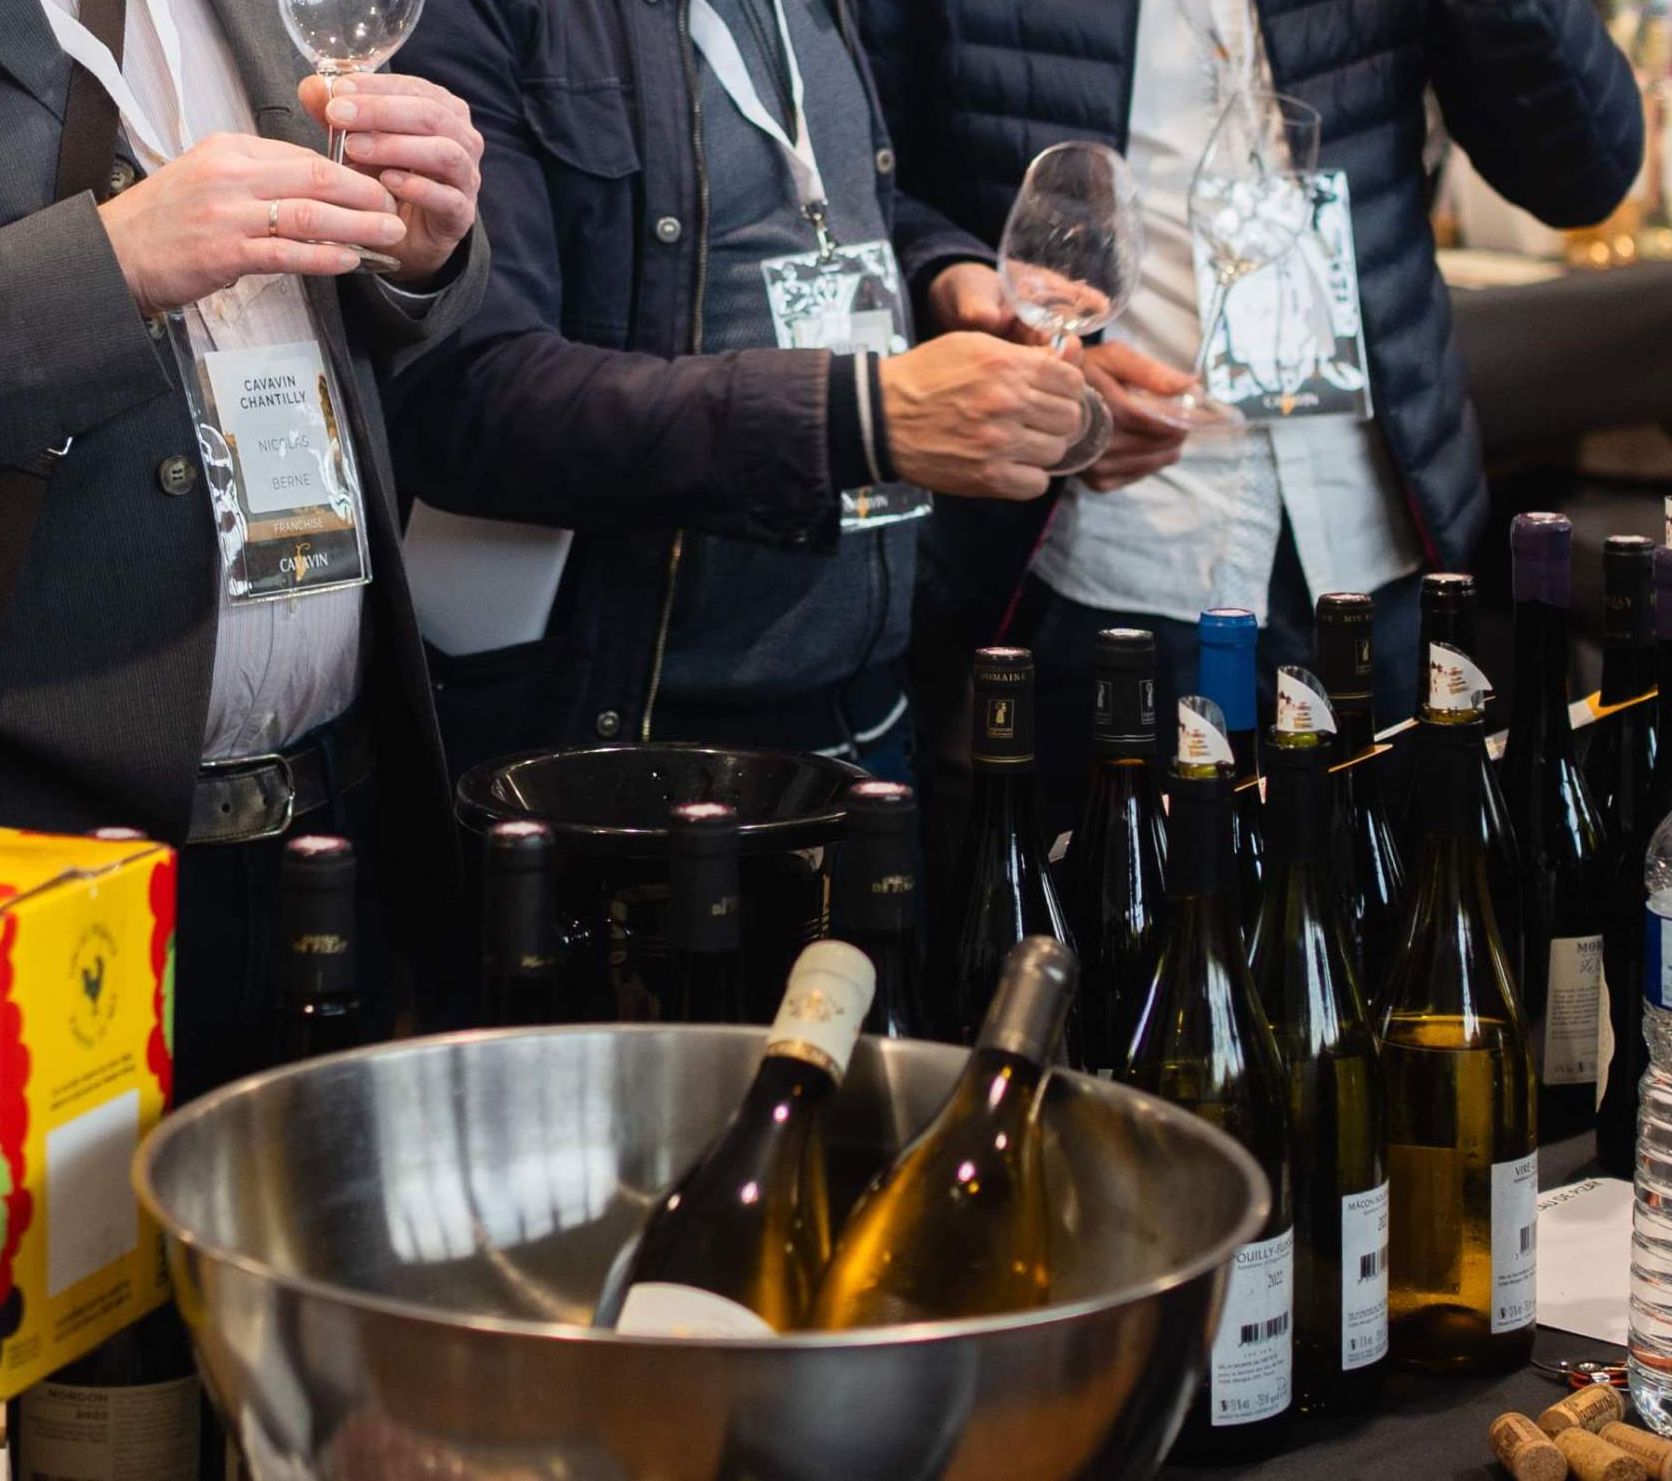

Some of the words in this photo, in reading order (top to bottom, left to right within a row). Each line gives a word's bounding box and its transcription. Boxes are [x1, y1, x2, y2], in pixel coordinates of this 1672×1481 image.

[243, 374, 297, 393] CAVAVIN
[239, 389, 307, 410] CHANTILLY
[258, 435, 310, 453] NICOLAS
[272, 473, 312, 491] BERNE
[273, 518, 324, 534] FRANCHISE
